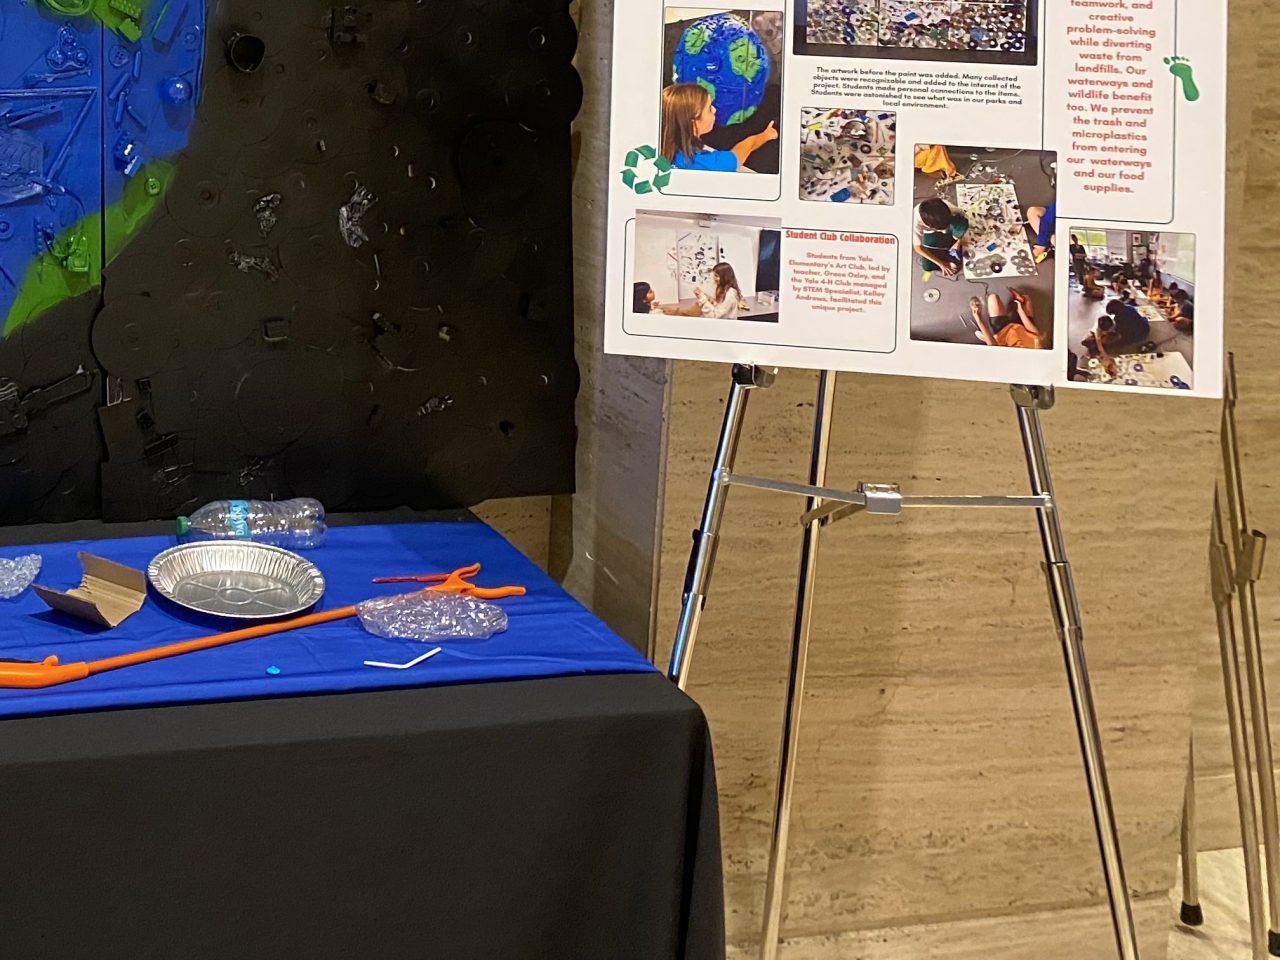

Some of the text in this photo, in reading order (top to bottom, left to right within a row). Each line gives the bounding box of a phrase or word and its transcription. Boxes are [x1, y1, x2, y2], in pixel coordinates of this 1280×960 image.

[1071, 0, 1153, 9] teamwork, and
[1089, 13, 1134, 22] creative
[1067, 24, 1156, 39] problem-solving
[785, 230, 895, 244] Student Club Collaboration
